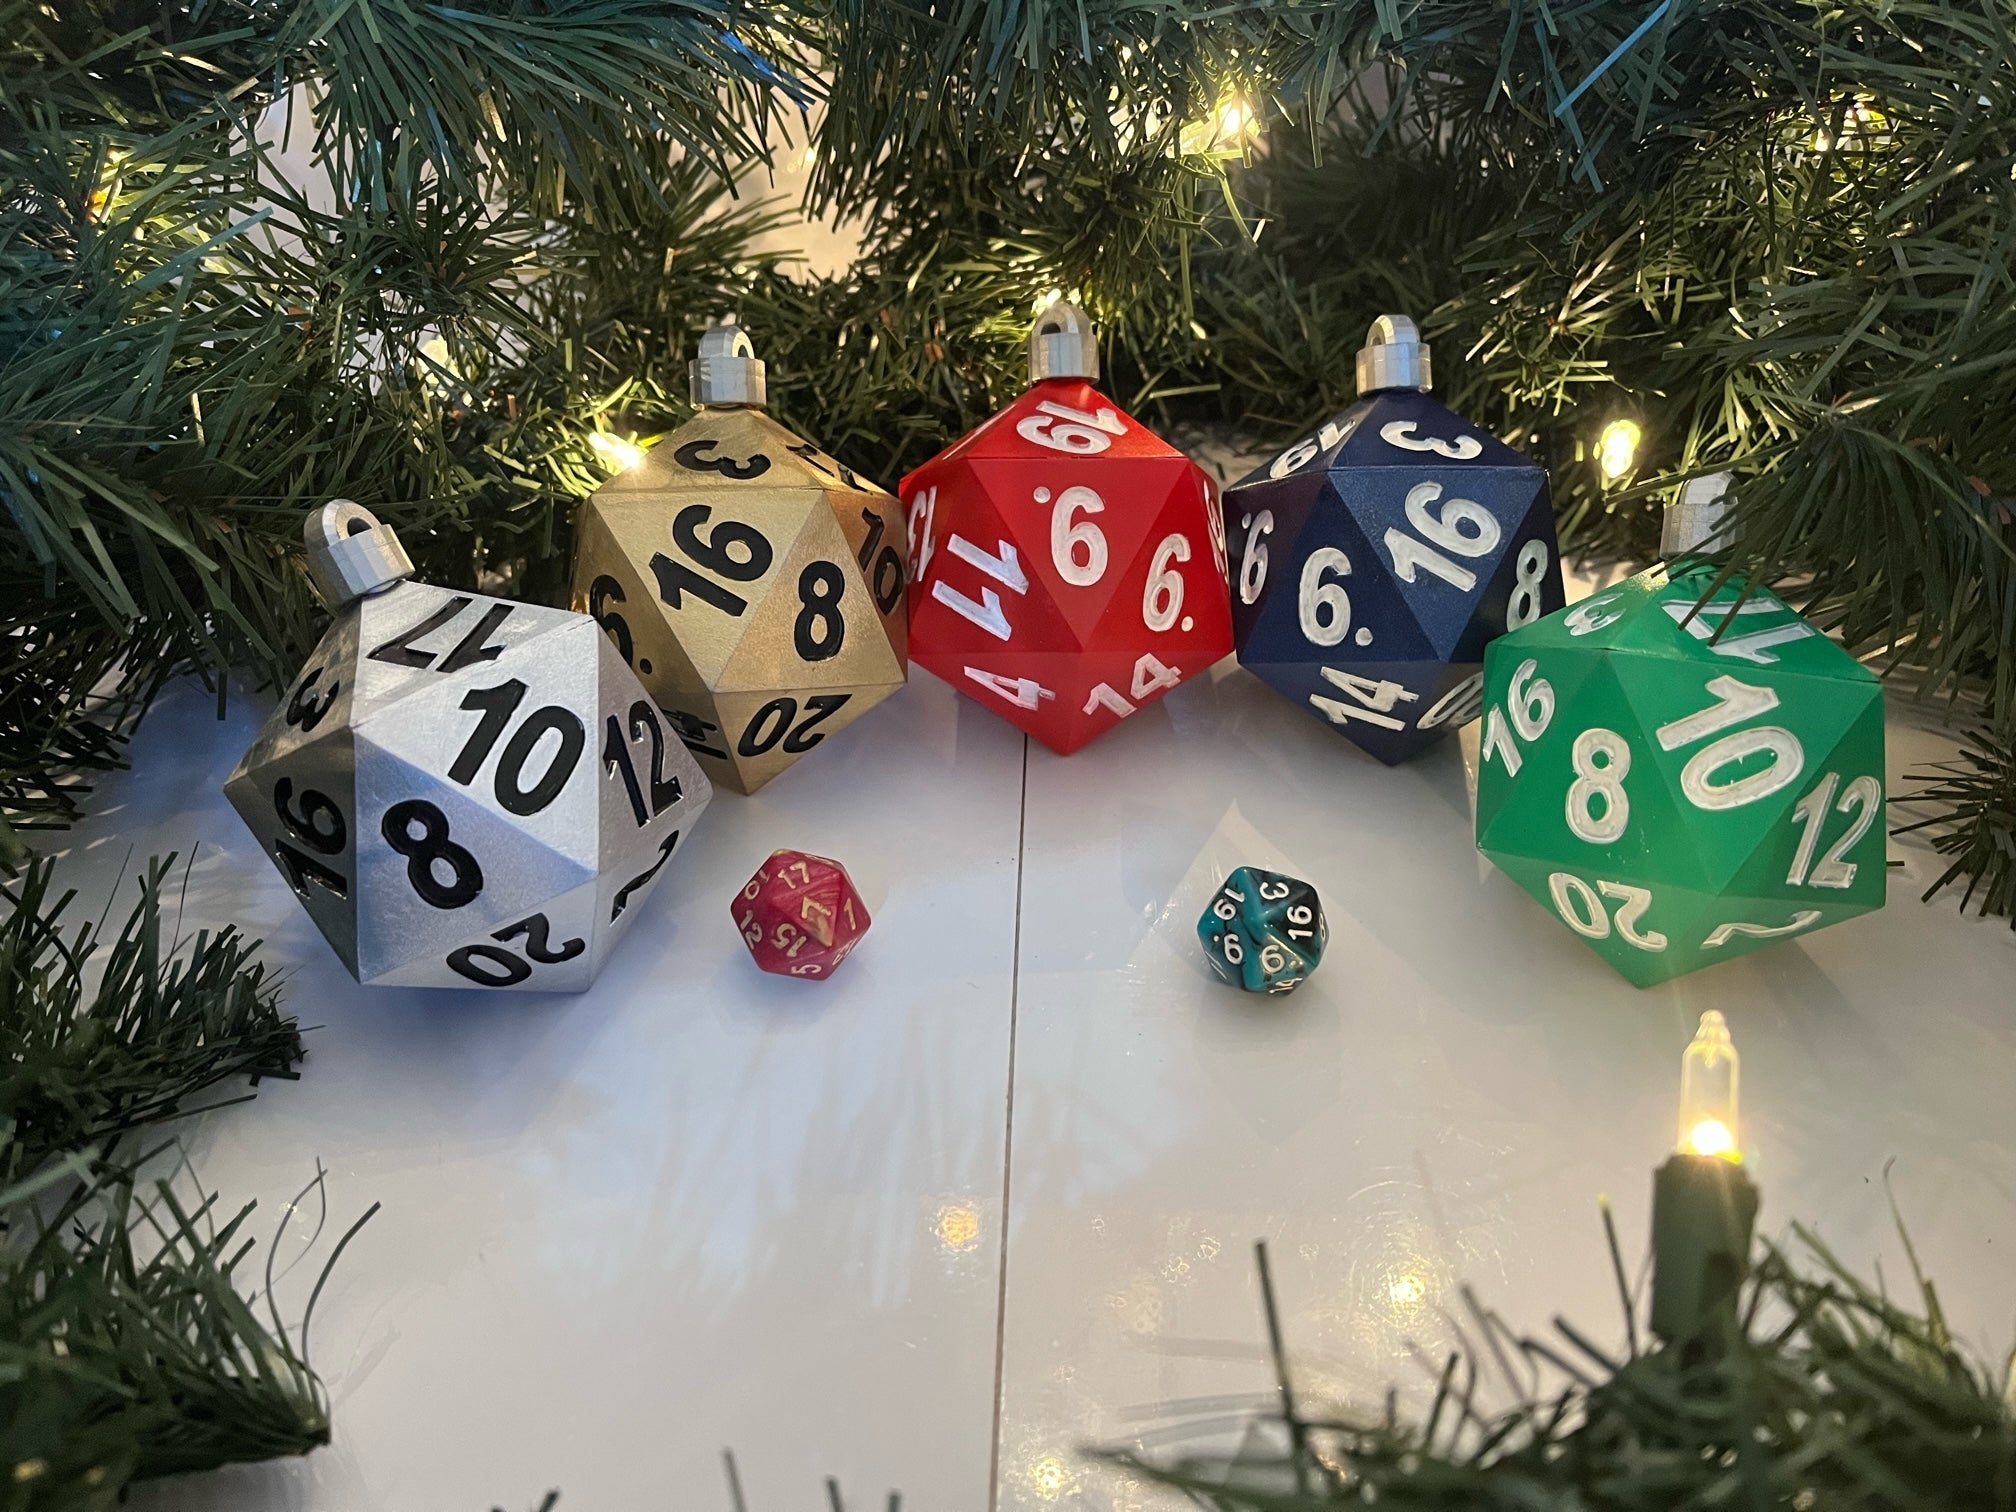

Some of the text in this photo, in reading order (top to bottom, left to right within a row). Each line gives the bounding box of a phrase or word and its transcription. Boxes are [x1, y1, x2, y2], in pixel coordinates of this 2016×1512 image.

[673, 440, 771, 480] 3
[1016, 400, 1129, 454] 19
[1380, 420, 1482, 460] 3
[649, 504, 774, 617] 16
[858, 506, 904, 616] 10
[1383, 480, 1501, 592] 16
[794, 560, 845, 661] 8
[931, 533, 1029, 642] 11
[1506, 539, 1548, 633] 8
[1564, 593, 1626, 636] 3
[367, 596, 515, 672] 17
[1660, 597, 1815, 664] 17
[287, 667, 340, 732] 3
[963, 665, 1056, 711] 4
[1082, 652, 1182, 719] 14
[1309, 666, 1419, 731] 14
[1482, 659, 1555, 777] 16
[448, 678, 585, 816] 10
[738, 693, 852, 757] 20
[1656, 675, 1804, 810] 10
[603, 700, 684, 828] 12
[1565, 728, 1631, 844] 8
[274, 777, 347, 900] 16
[381, 799, 484, 910] 8
[1786, 772, 1881, 888] 12
[778, 861, 809, 889] 17
[1213, 887, 1245, 920] 19
[1260, 882, 1289, 900] 3
[740, 909, 763, 950] 12
[770, 923, 807, 957] 15
[844, 897, 856, 930] 1
[1286, 905, 1313, 940] 16
[1548, 873, 1668, 952] 20
[446, 912, 586, 987] 20
